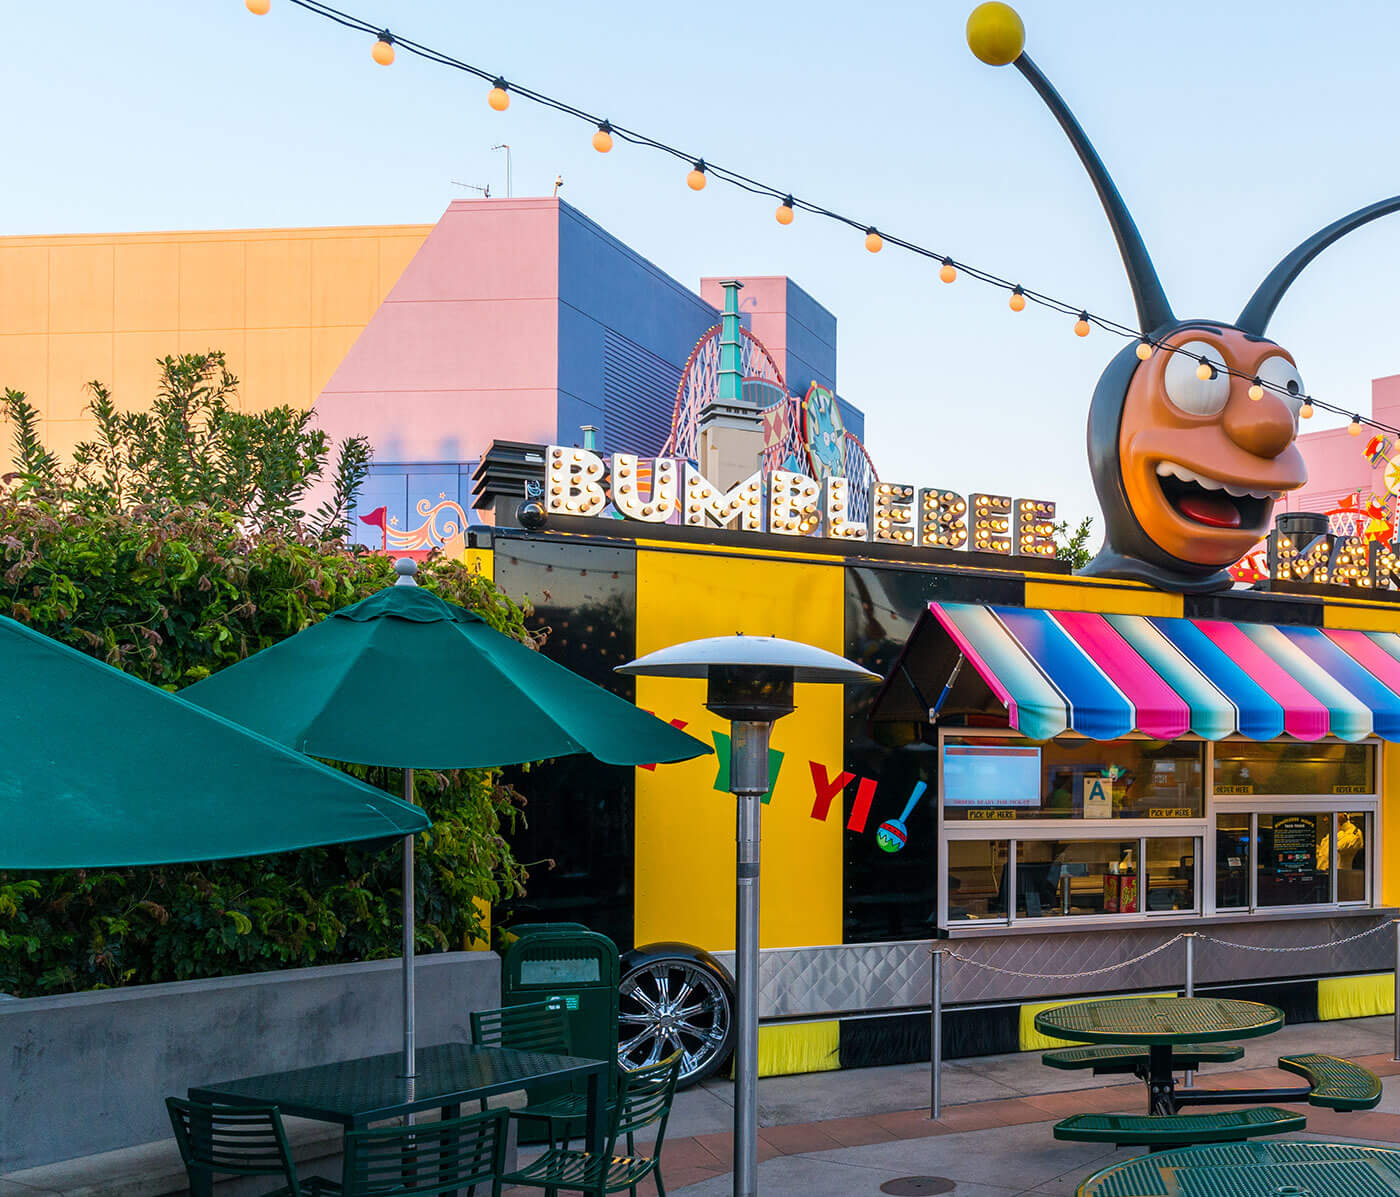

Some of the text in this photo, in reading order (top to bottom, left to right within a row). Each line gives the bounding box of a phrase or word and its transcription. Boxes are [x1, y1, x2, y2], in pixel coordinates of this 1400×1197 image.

[545, 445, 1056, 558] BUMBLEBEE
[1089, 781, 1106, 801] A
[969, 810, 1014, 818] PICK UP HERE
